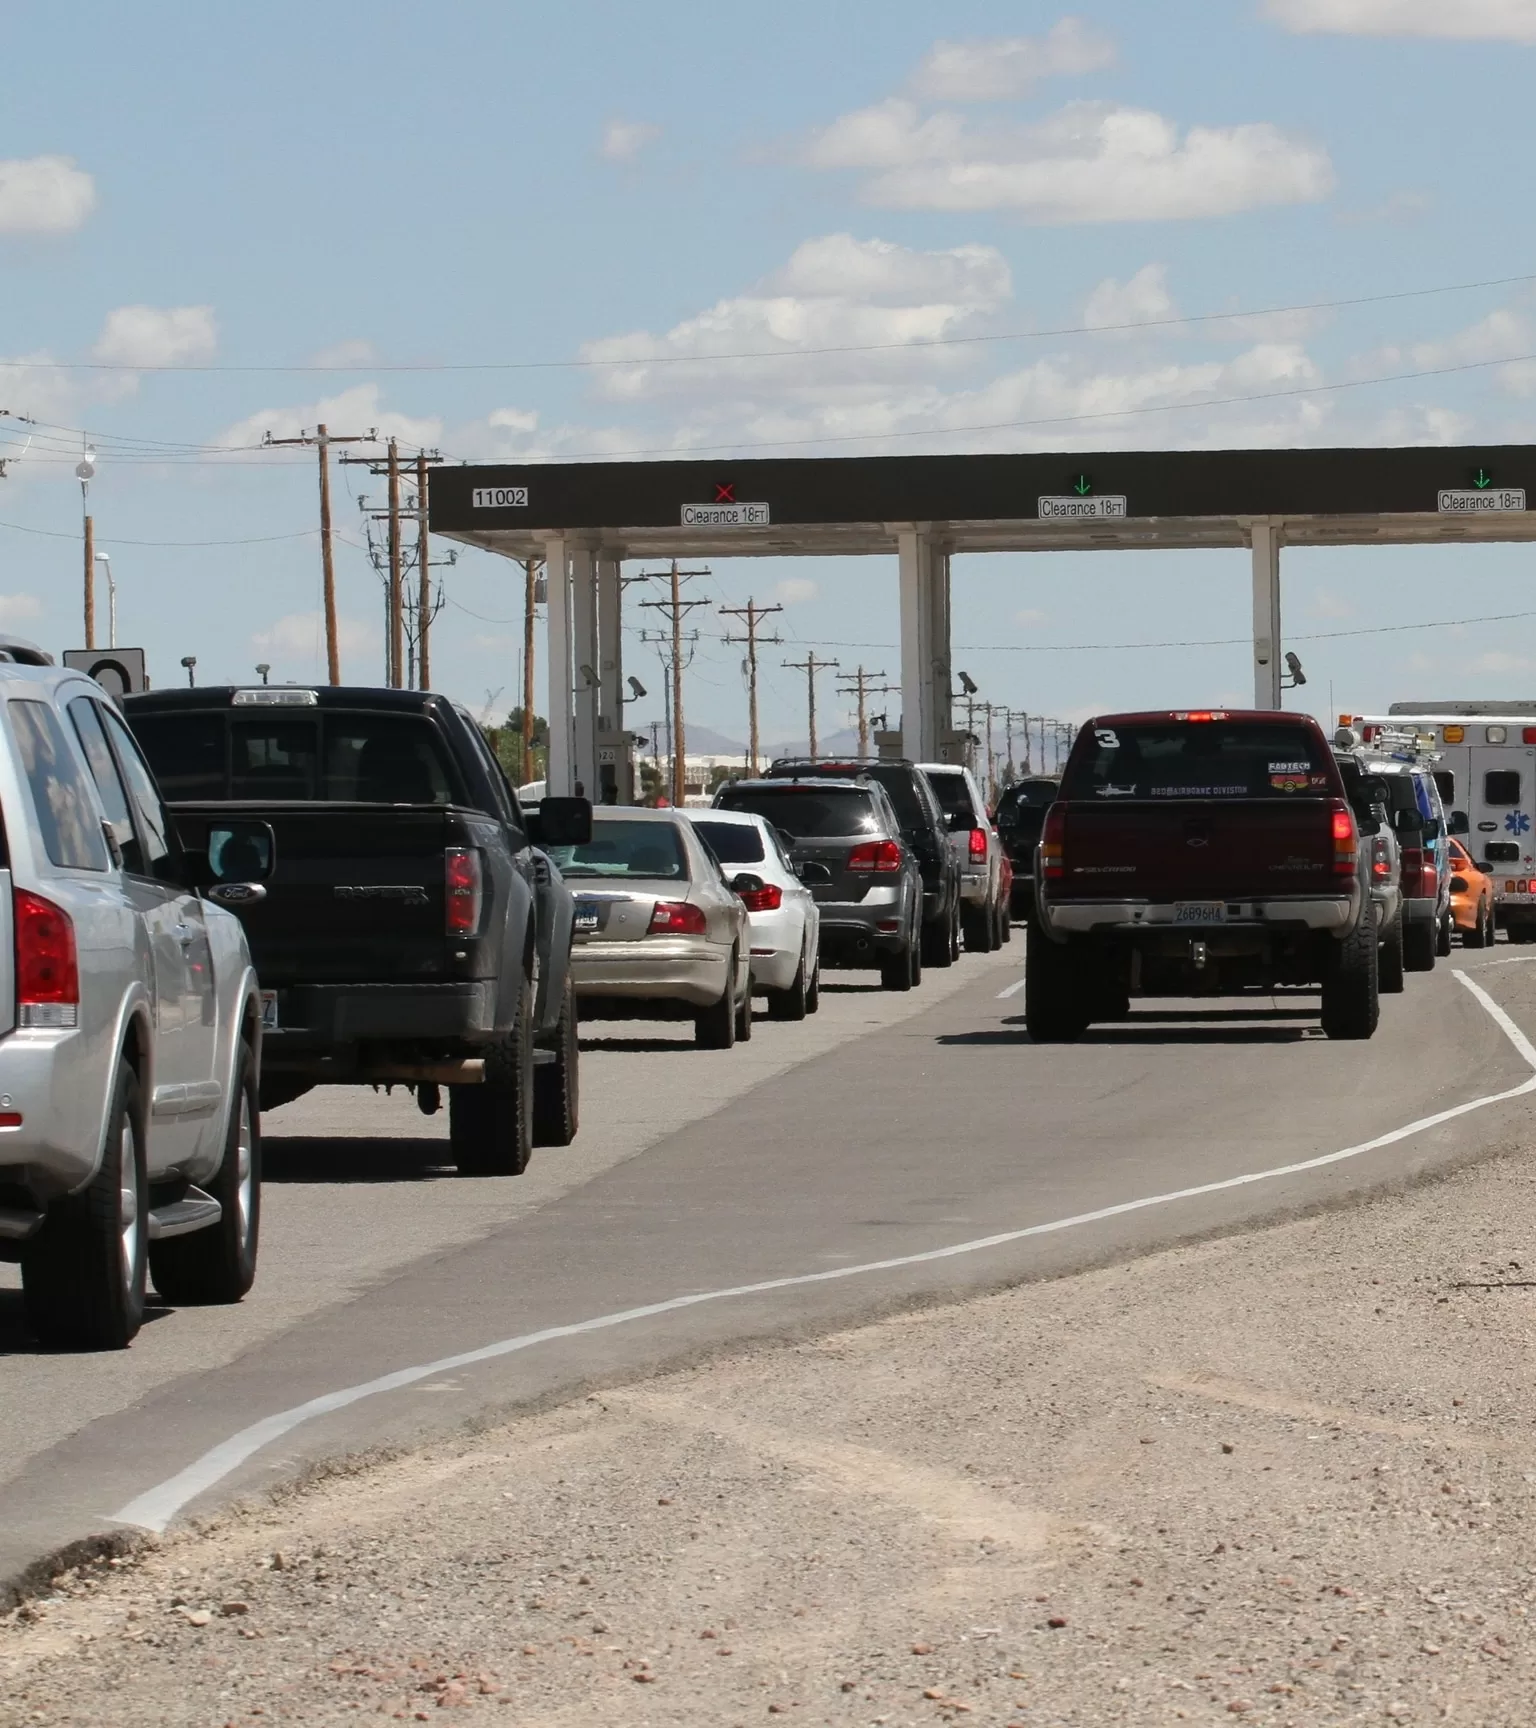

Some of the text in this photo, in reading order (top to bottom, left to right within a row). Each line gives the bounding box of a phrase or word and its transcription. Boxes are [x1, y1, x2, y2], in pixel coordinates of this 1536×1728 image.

[476, 489, 525, 506] 11002
[1441, 493, 1495, 510] Clearance
[684, 507, 739, 523] Clearance
[1042, 500, 1096, 516] Clearance
[1094, 729, 1120, 748] 3
[1268, 762, 1311, 771] FABTECH
[1213, 785, 1248, 794] DIVISION
[223, 886, 250, 898] Ford
